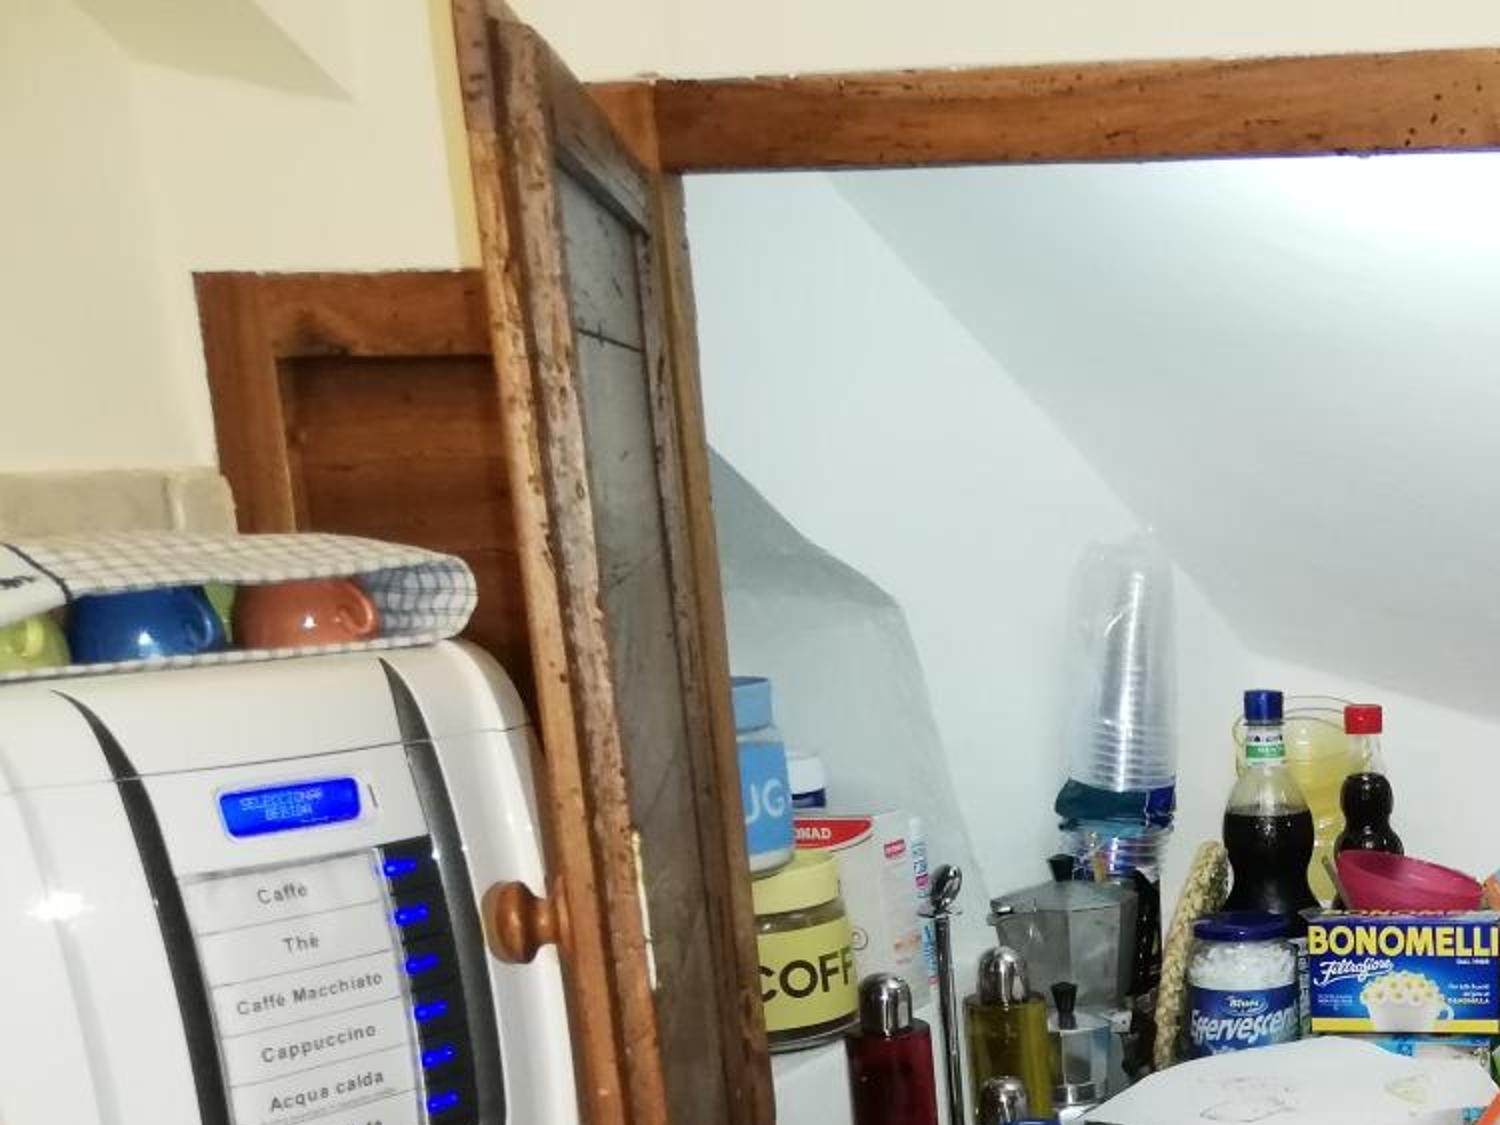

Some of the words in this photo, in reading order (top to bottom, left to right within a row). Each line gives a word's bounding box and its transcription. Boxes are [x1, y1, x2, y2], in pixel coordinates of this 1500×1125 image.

[1307, 925, 1499, 957] BONOMELLI
[292, 973, 383, 1004] Macchiato
[261, 1025, 377, 1063] Cappuccino
[270, 1087, 329, 1112] Acqua
[335, 1070, 385, 1094] calda
